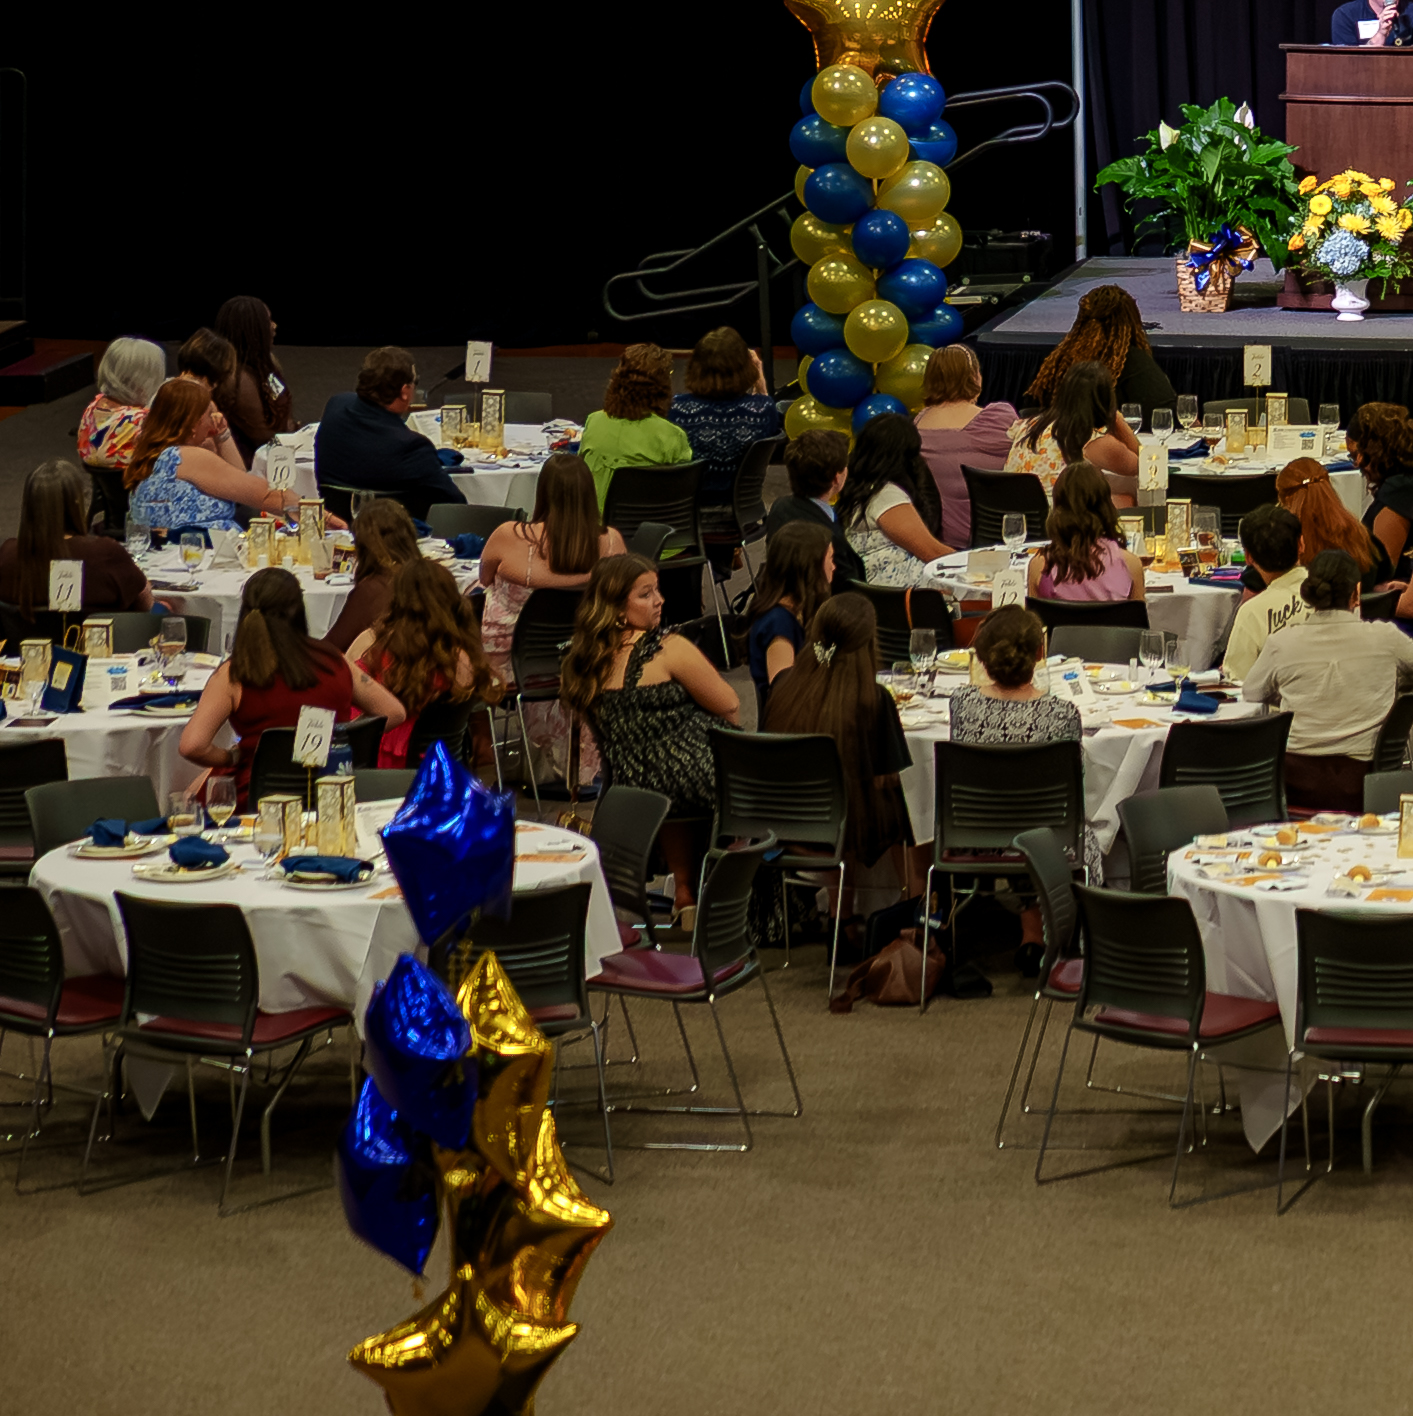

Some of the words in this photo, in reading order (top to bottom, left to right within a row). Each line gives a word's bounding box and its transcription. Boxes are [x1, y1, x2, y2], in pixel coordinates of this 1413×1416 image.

[1252, 363, 1262, 378] 2
[273, 465, 290, 482] 10
[56, 583, 73, 601] 11
[1000, 591, 1018, 607] 12
[300, 732, 323, 754] 19
